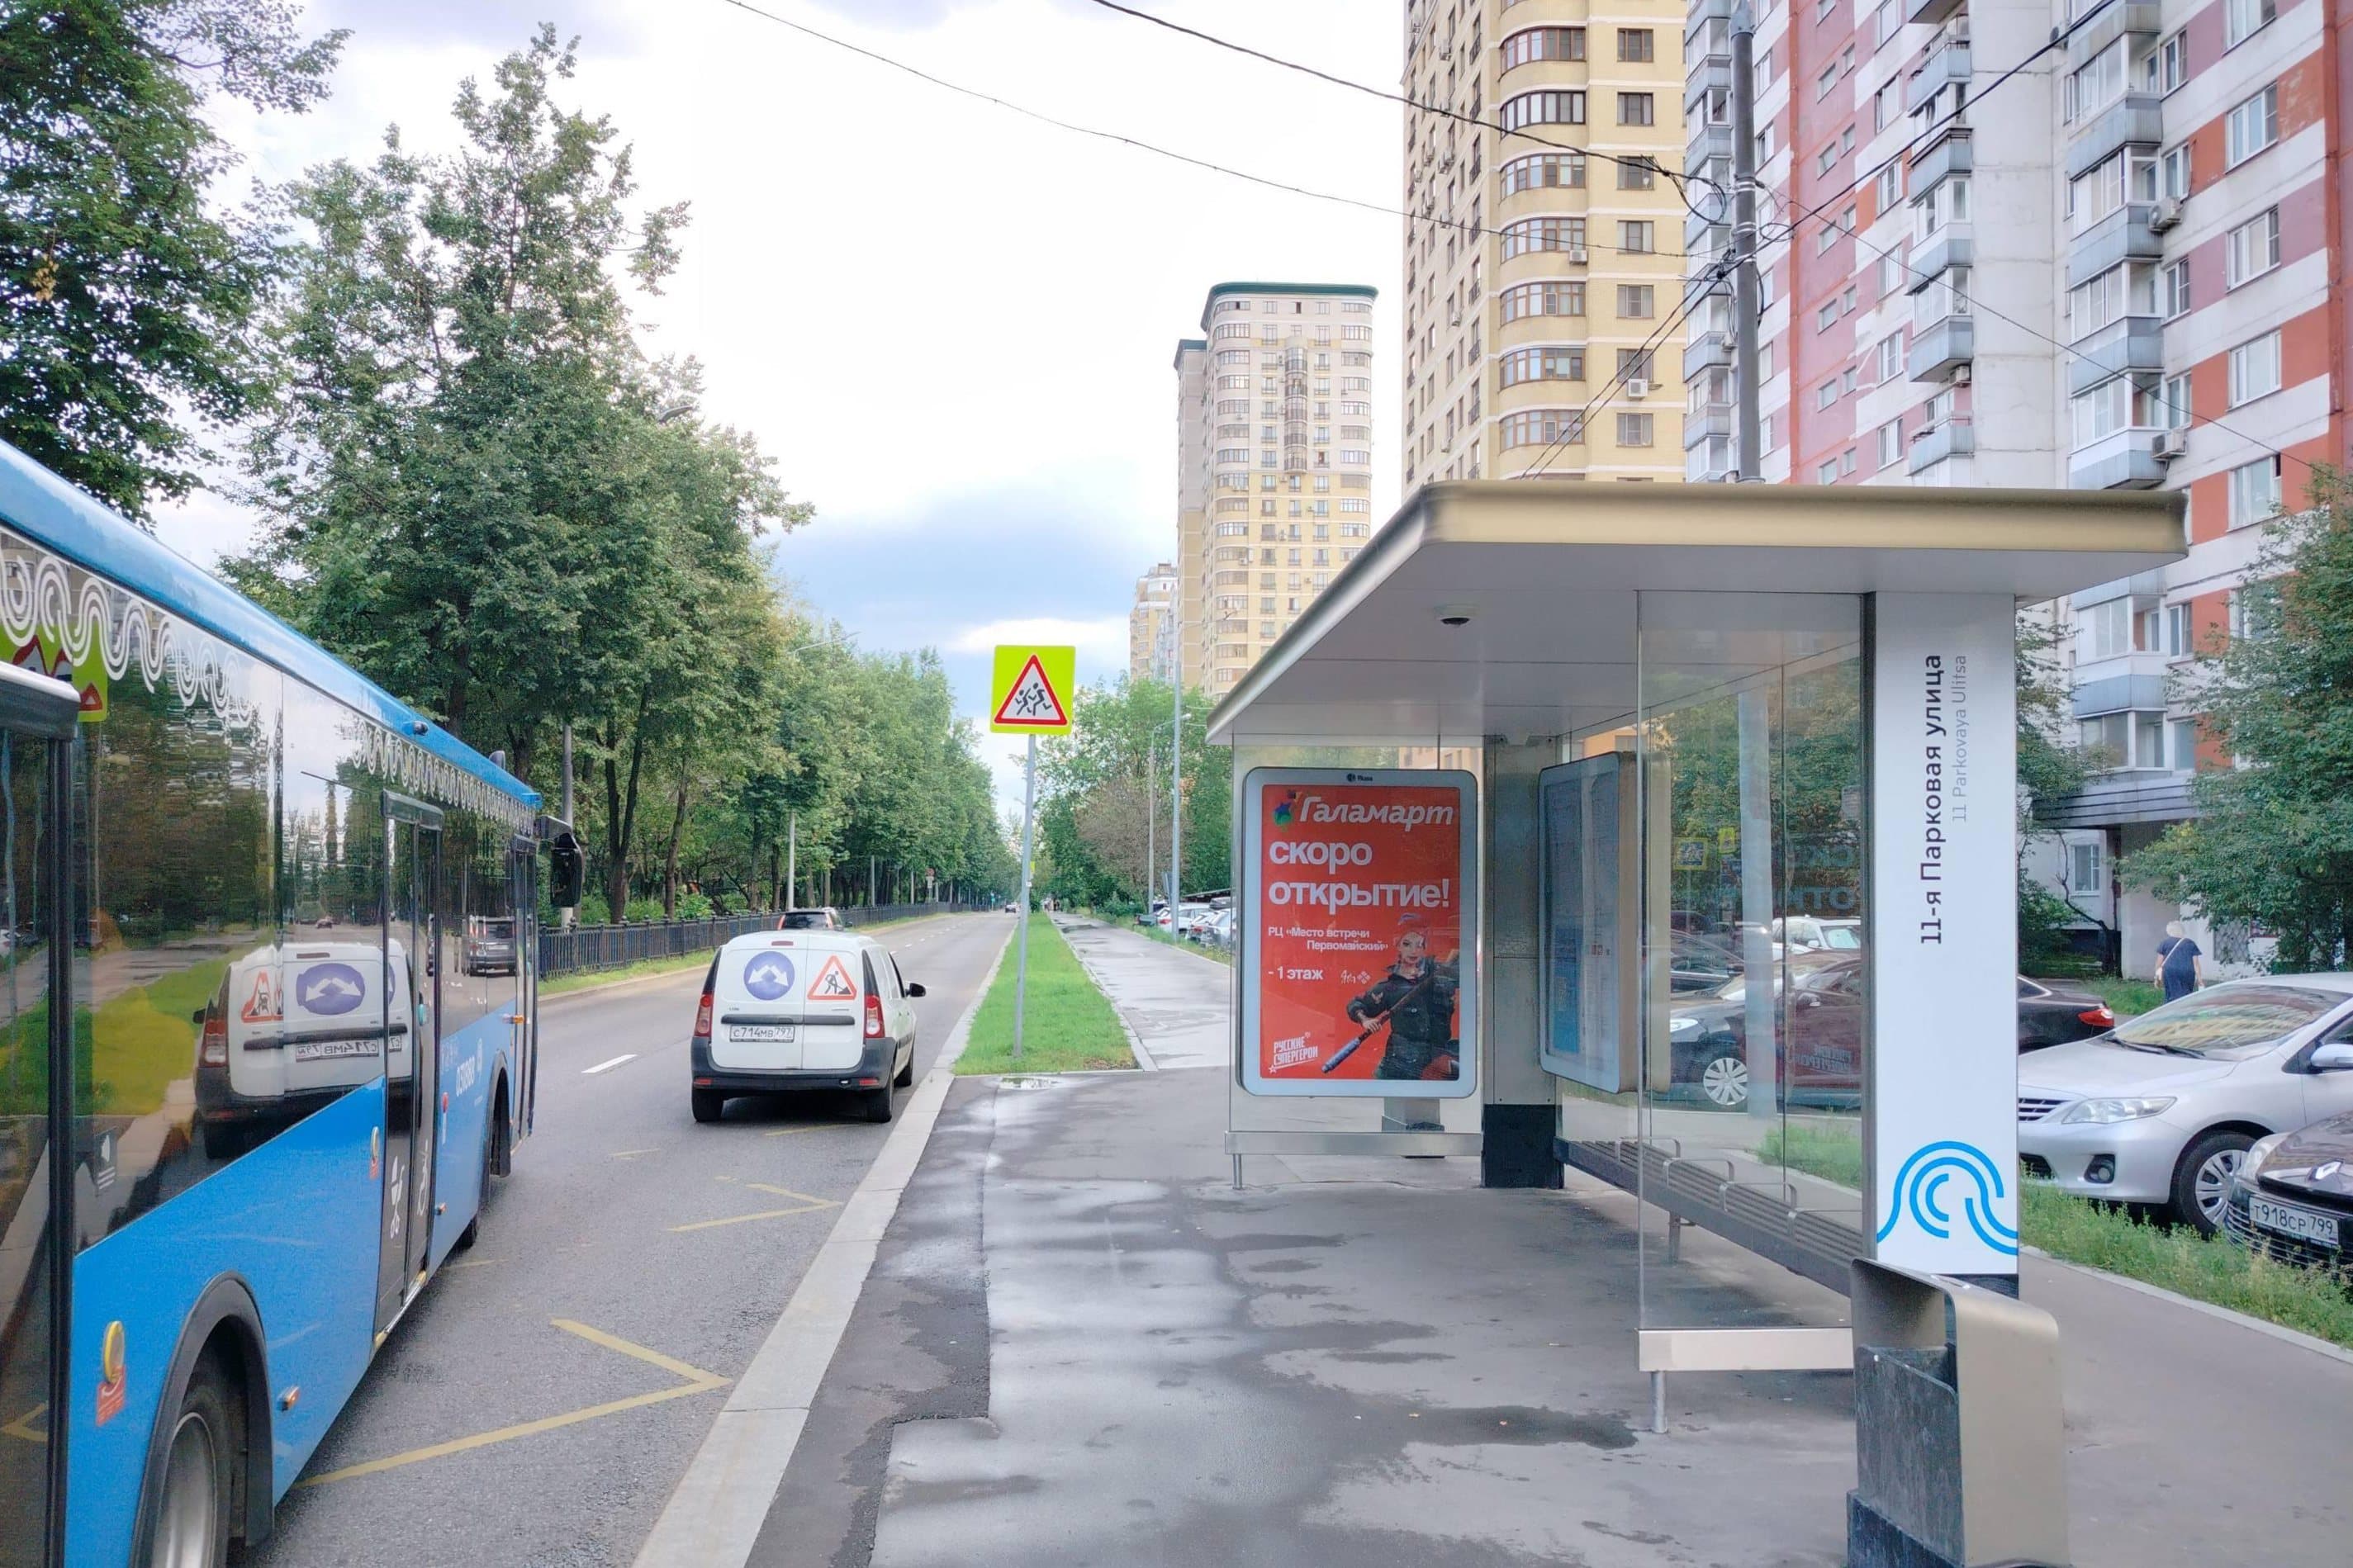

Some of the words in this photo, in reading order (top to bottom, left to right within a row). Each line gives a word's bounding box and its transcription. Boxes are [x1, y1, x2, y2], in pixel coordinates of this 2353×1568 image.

[1925, 655, 1946, 737] улица
[1951, 655, 1967, 703] Ulitsa
[1952, 708, 1970, 798] Parkovaya
[1299, 795, 1454, 832] Галамарт
[1920, 746, 1946, 880] Парковая
[1952, 804, 1967, 822] 11
[1269, 841, 1373, 875] скоро
[1268, 879, 1450, 916] открытие!
[1286, 927, 1323, 938] «Место
[1326, 928, 1370, 940] встречи
[1920, 890, 1942, 944] 11-я
[1307, 940, 1388, 954] Первомайский»
[1287, 969, 1323, 981] этаж
